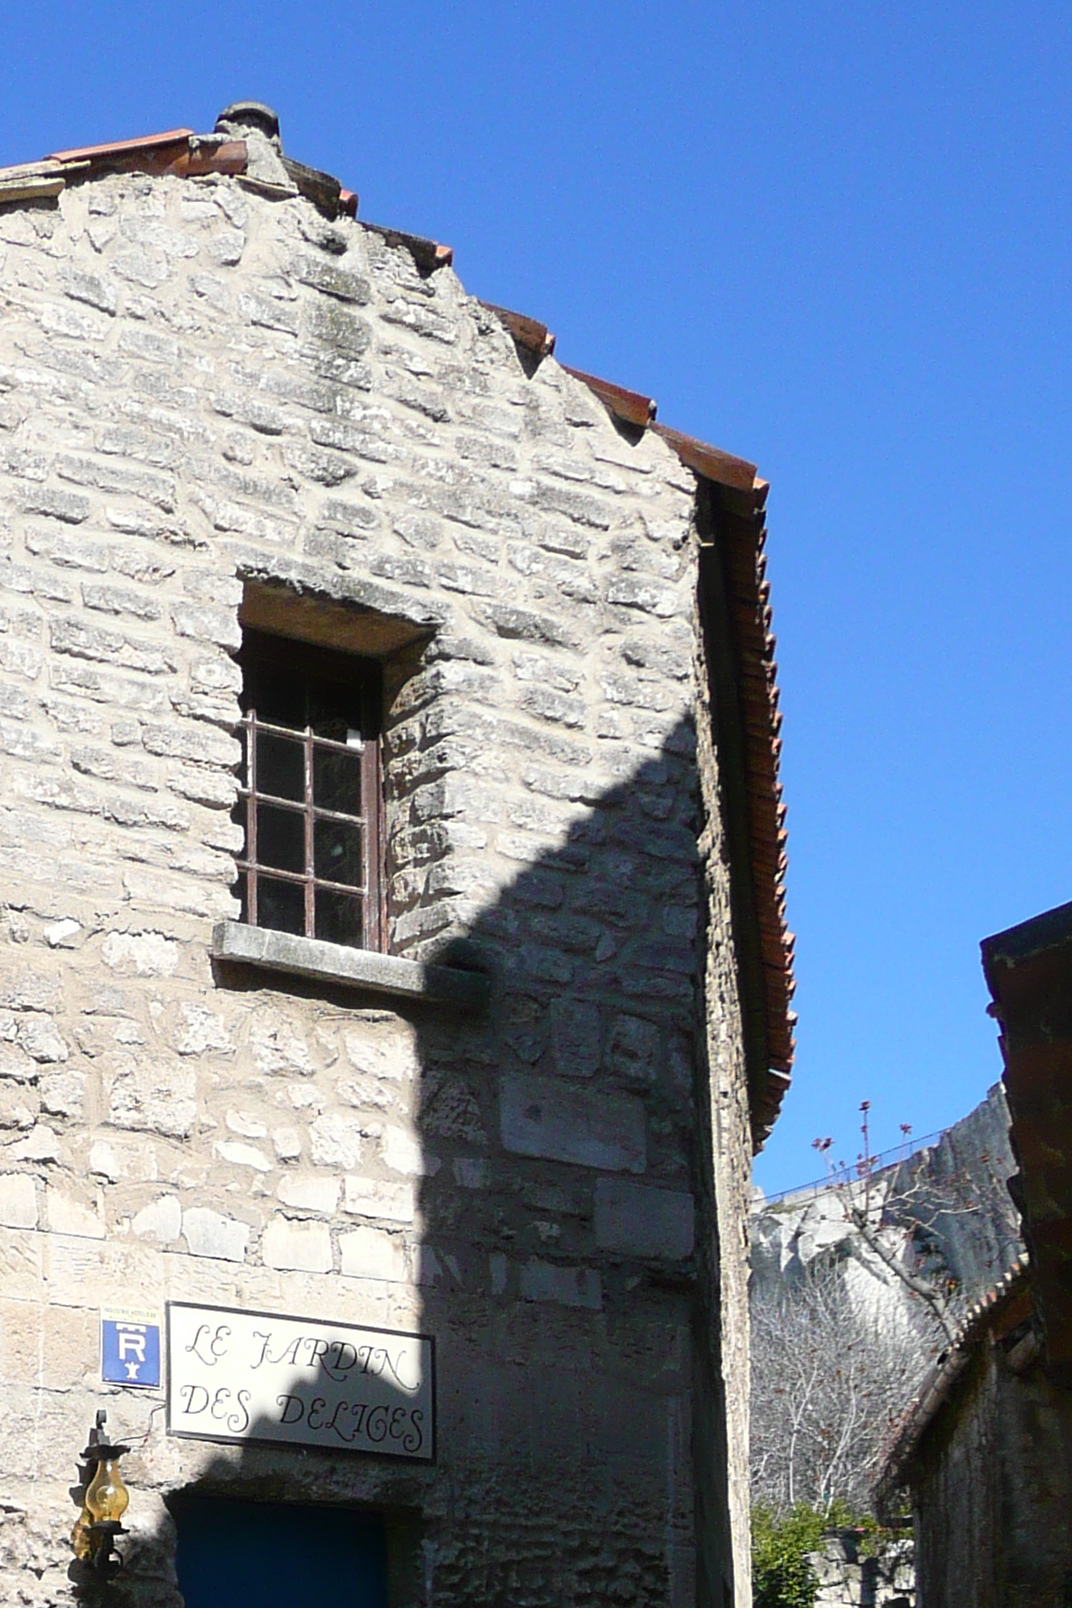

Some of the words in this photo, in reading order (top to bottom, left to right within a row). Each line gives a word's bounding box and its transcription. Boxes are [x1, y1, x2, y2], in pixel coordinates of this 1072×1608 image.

[185, 1324, 232, 1366] LE
[250, 1331, 420, 1391] JARDIN
[180, 1384, 251, 1433] DES
